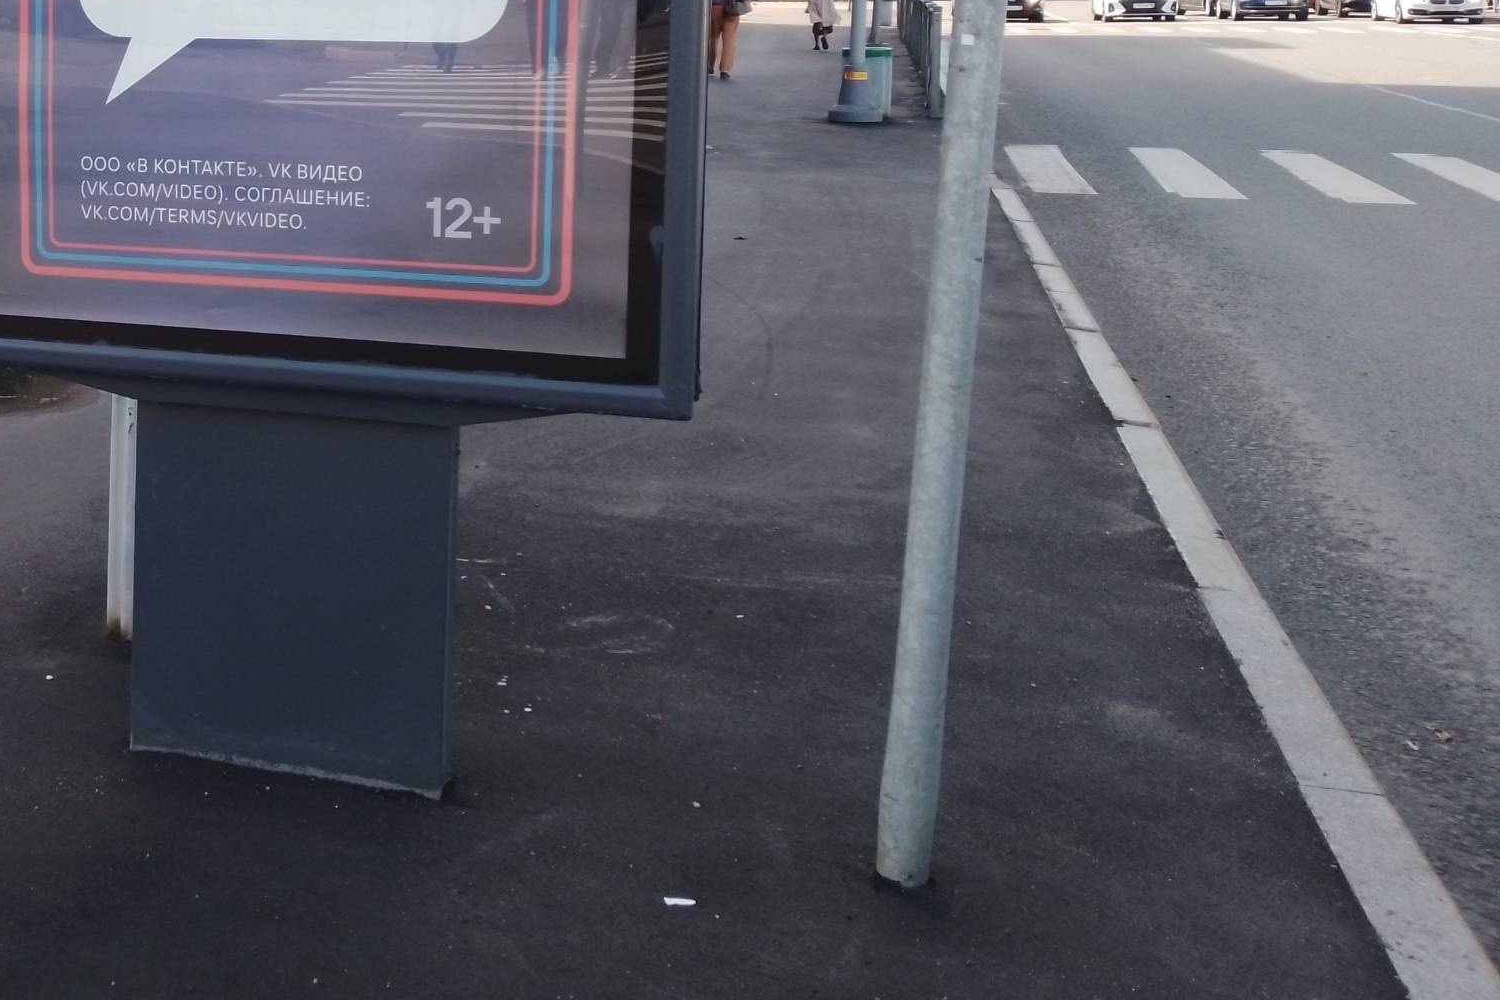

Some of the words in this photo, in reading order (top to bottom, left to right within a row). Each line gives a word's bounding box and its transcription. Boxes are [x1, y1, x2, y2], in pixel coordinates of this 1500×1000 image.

[80, 155, 121, 173] ООО
[126, 157, 148, 174] «В
[153, 159, 264, 179] КОНТАКТЕ».
[268, 163, 293, 180] VK
[297, 164, 364, 184] ВИДЕО
[80, 181, 230, 205] (VK.COM/VIDEO).
[234, 185, 372, 208] СОГЛАШЕНИЕ:
[80, 204, 308, 230] VK.COM/TERMS/VKVIDEO.
[425, 196, 502, 240] 12+
